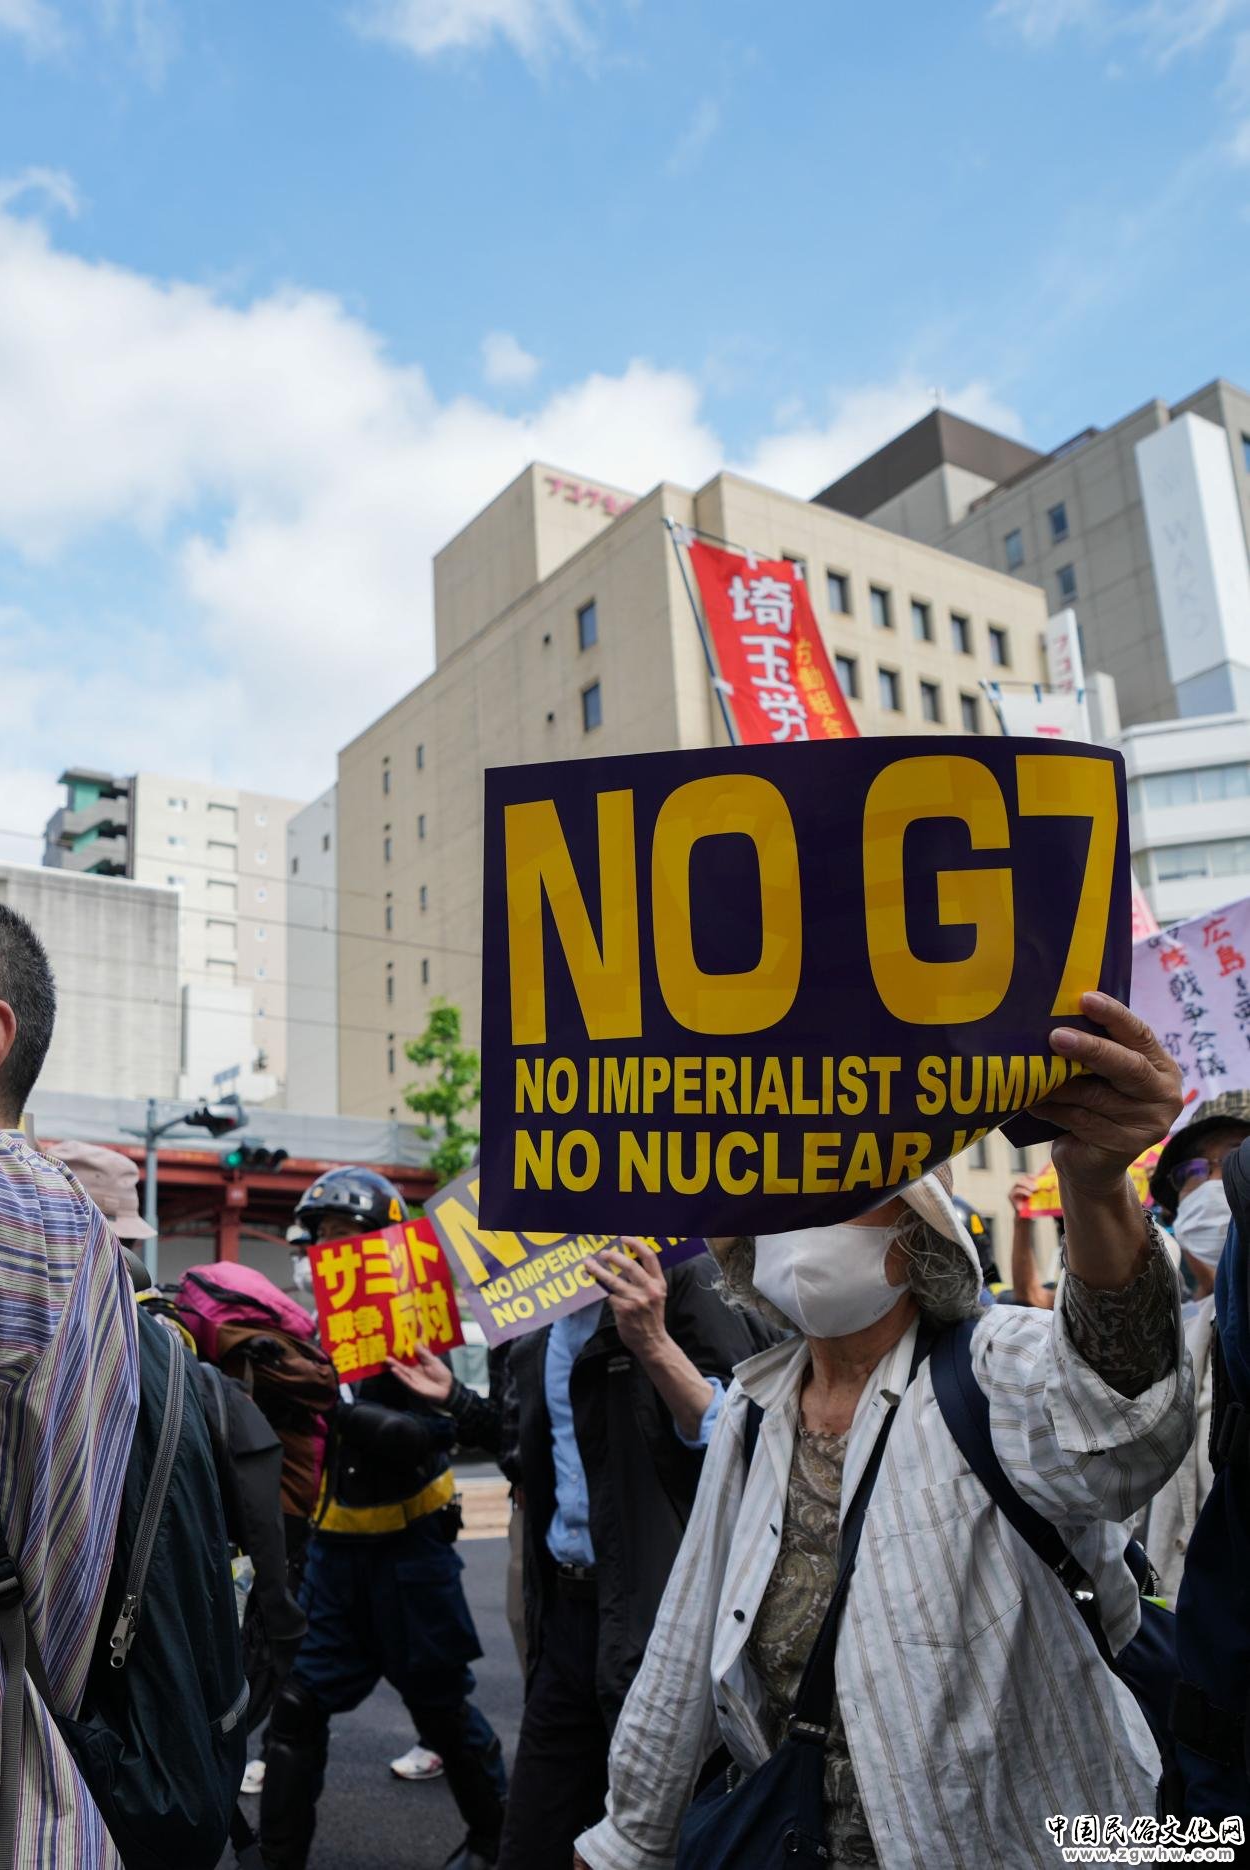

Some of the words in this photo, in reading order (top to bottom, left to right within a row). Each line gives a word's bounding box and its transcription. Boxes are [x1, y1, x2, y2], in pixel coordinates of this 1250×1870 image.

[503, 773, 803, 1046] NO
[862, 754, 1120, 1025] G7
[514, 1057, 579, 1115] NO
[588, 1056, 902, 1116] IMPERIALIST
[513, 1129, 601, 1193] NO
[619, 1130, 932, 1196] NUCLEAR
[316, 1226, 440, 1311] サミット
[479, 1277, 514, 1306] NO
[389, 1281, 454, 1360] 反対
[490, 1296, 536, 1329] NO
